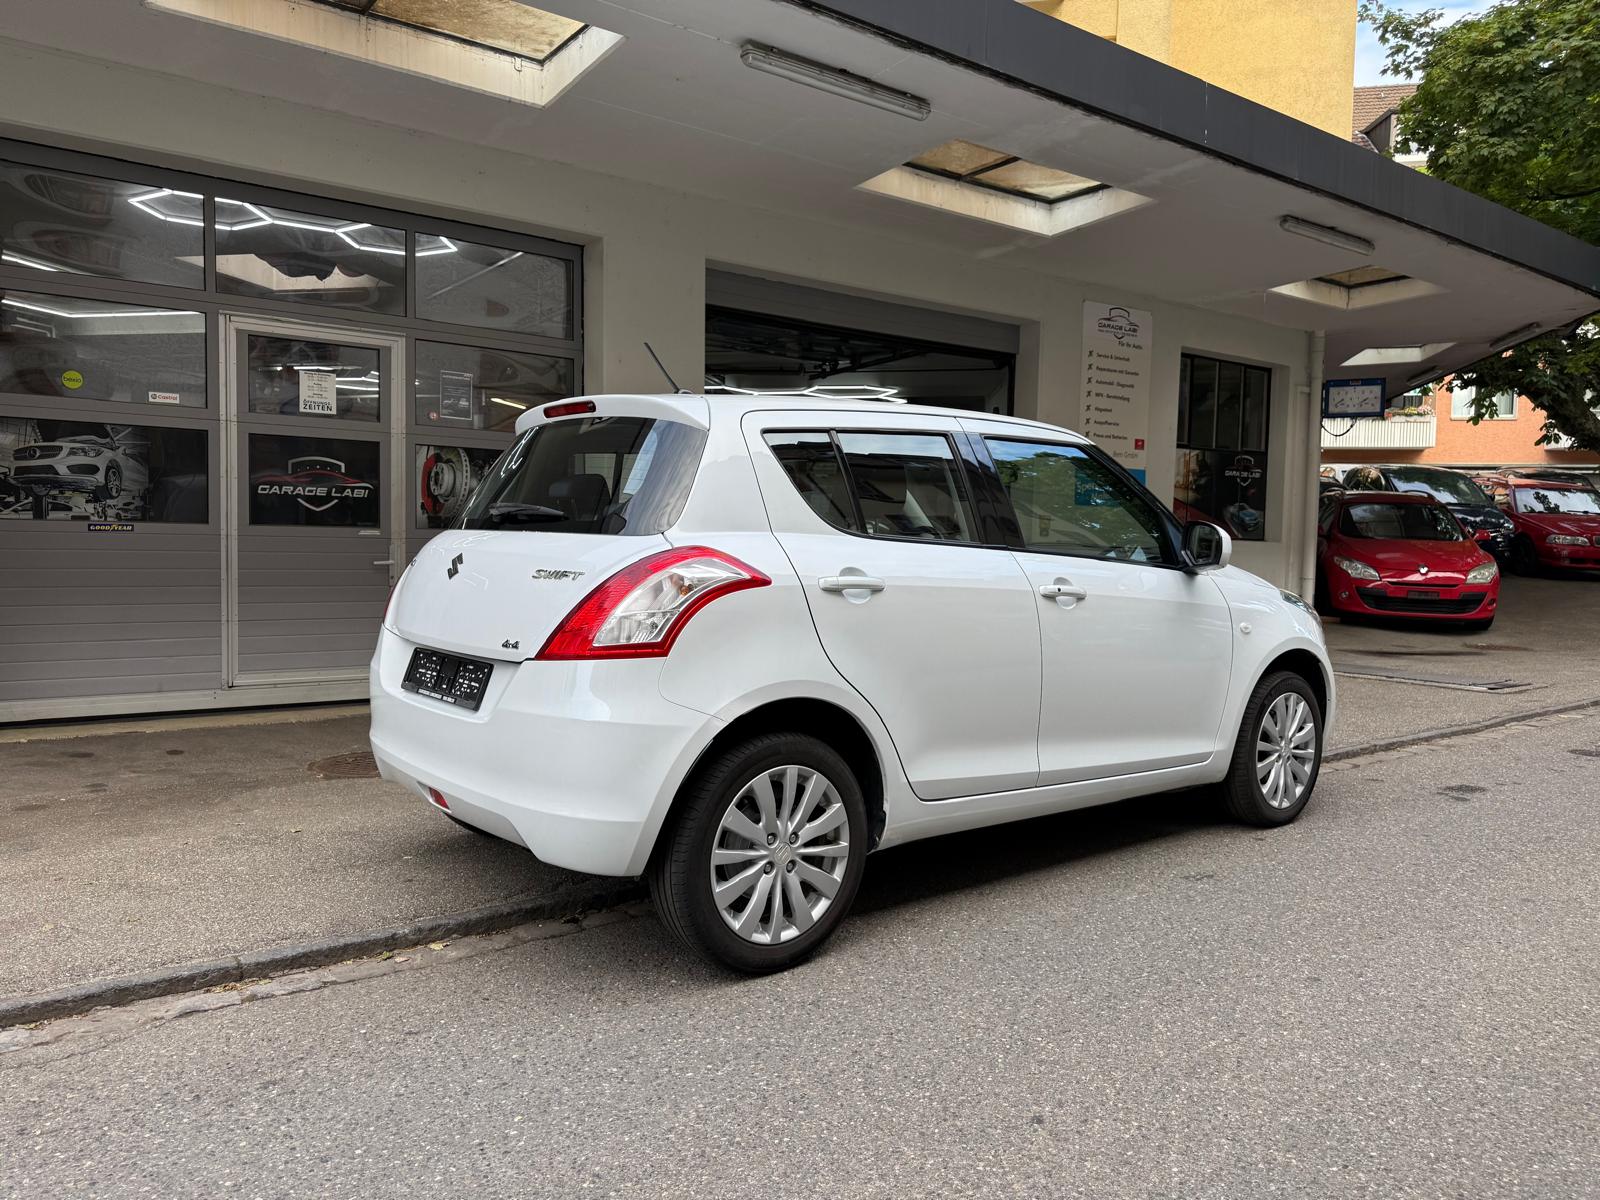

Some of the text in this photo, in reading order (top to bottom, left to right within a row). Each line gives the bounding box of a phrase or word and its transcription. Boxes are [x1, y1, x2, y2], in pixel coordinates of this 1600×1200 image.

[303, 403, 333, 412] ZEITEN
[257, 484, 328, 497] GARAGE
[89, 524, 133, 532] GOODYEAR
[531, 568, 586, 582] SWIFT
